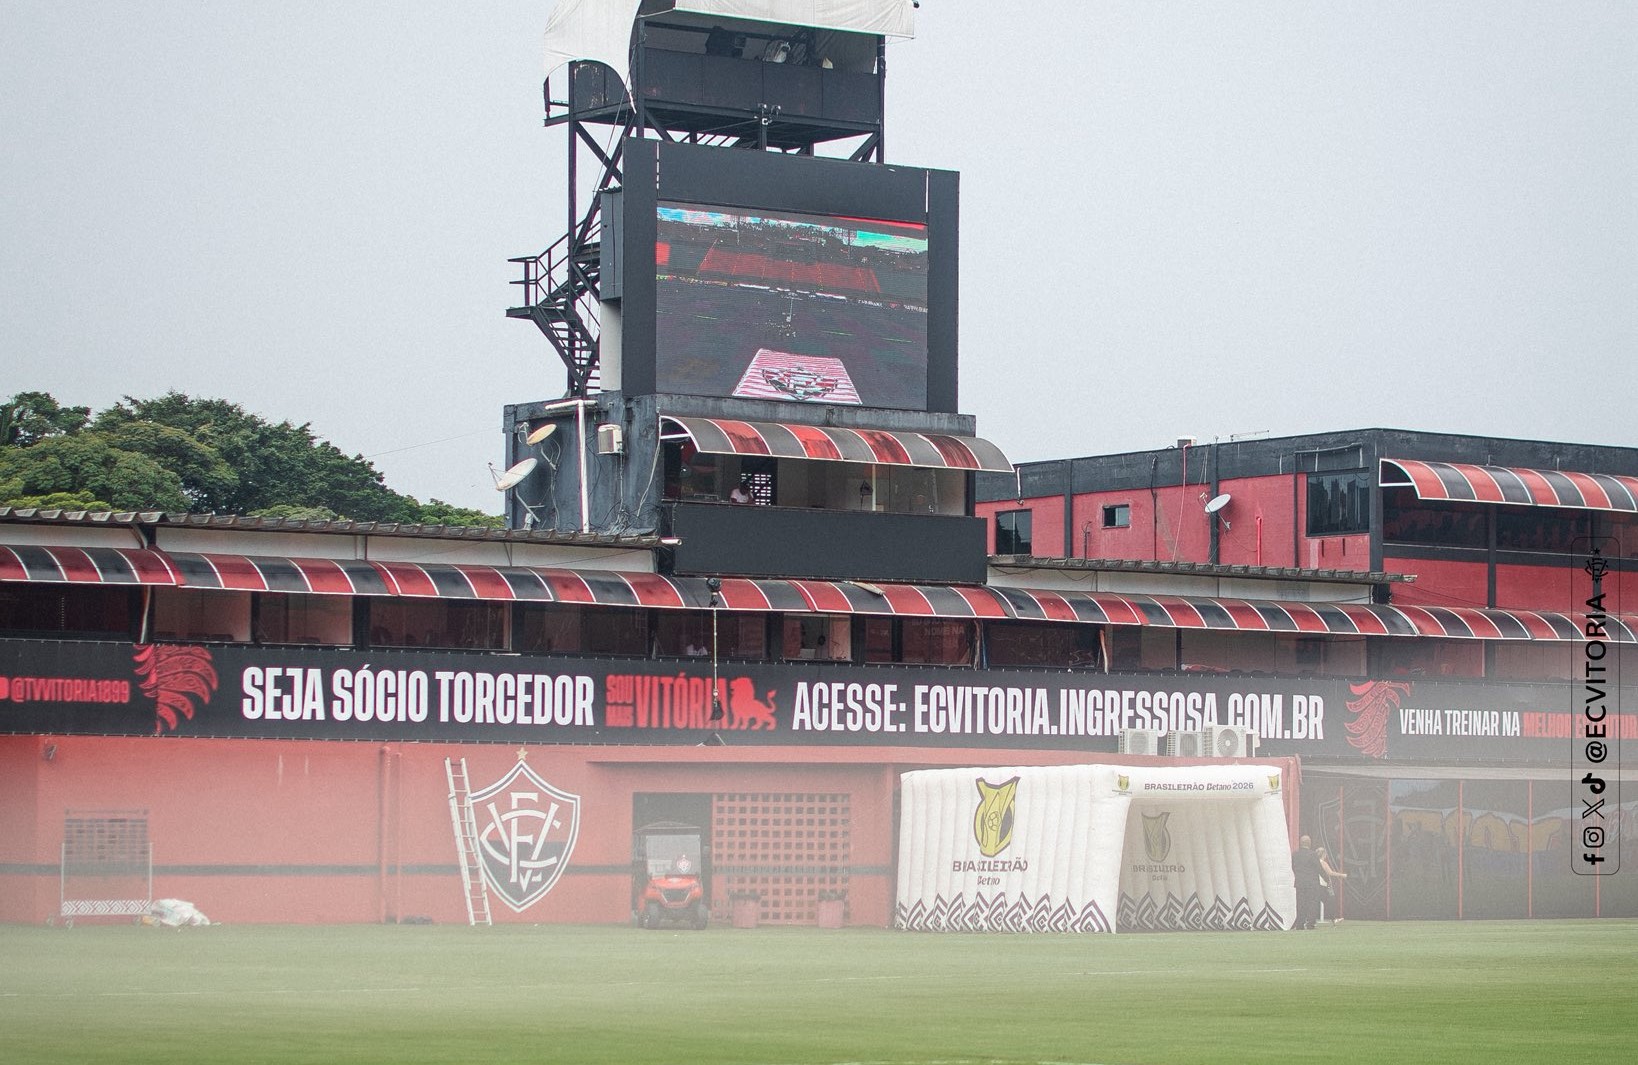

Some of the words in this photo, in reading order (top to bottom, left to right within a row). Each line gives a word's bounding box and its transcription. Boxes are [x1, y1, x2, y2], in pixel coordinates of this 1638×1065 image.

[242, 666, 326, 721] SEJA
[332, 664, 429, 723] SÓCIO
[435, 670, 595, 726] TORCEDOR
[792, 681, 906, 733] ACESSE:
[1399, 708, 1442, 736] VENHA
[1444, 710, 1500, 737] TREINAR
[1502, 711, 1520, 737] NA
[1144, 782, 1205, 791] BRASILEIRÃO
[1232, 782, 1254, 790] 2026
